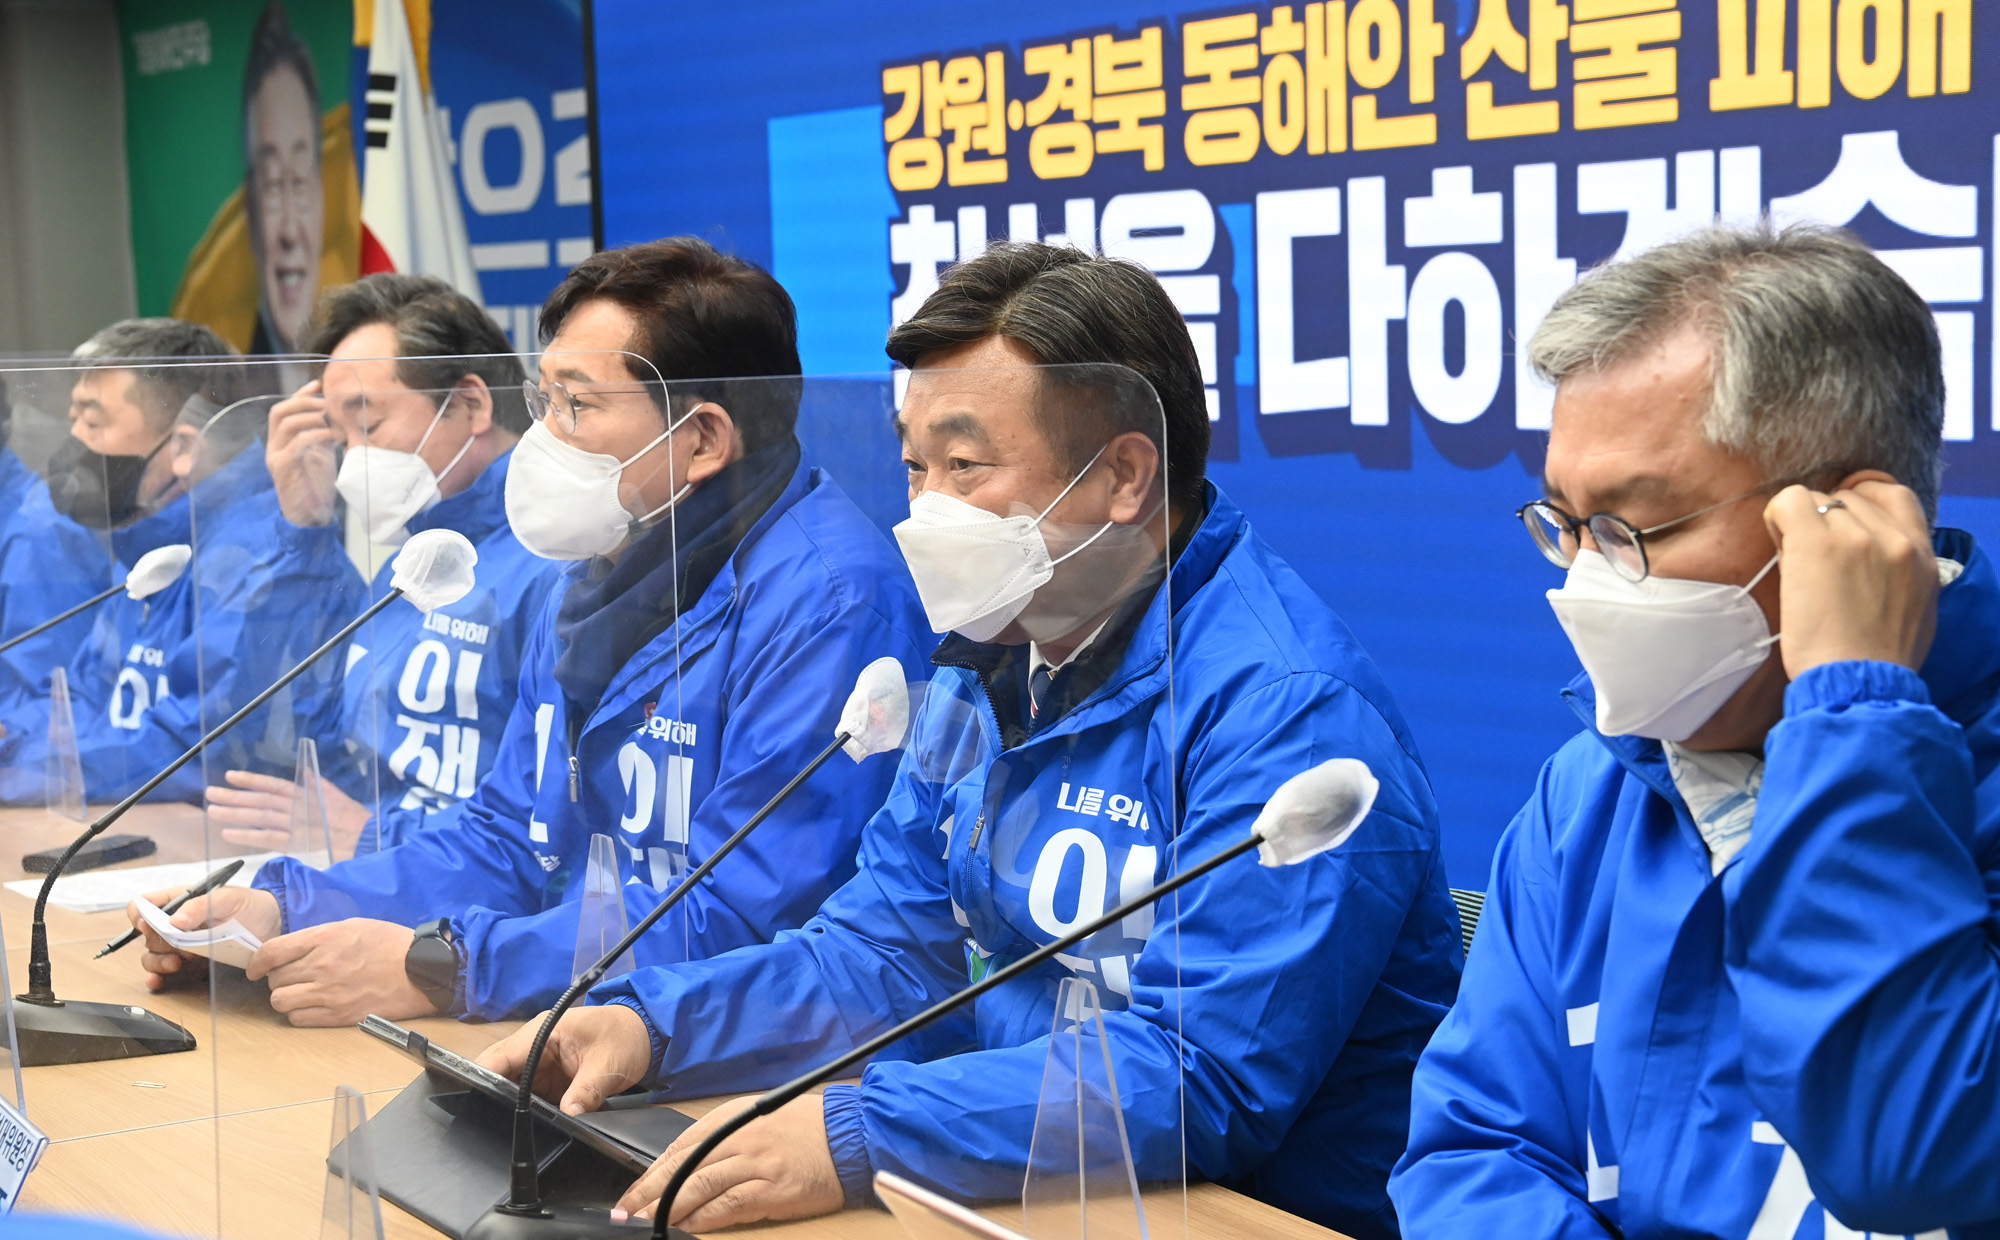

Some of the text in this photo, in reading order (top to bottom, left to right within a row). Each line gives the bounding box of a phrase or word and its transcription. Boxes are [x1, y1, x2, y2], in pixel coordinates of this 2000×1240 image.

[882, 0, 1971, 191] 강원·경북 동해안 산불 피해
[648, 716, 697, 746] 위해
[1057, 782, 1149, 831] 나를 위
